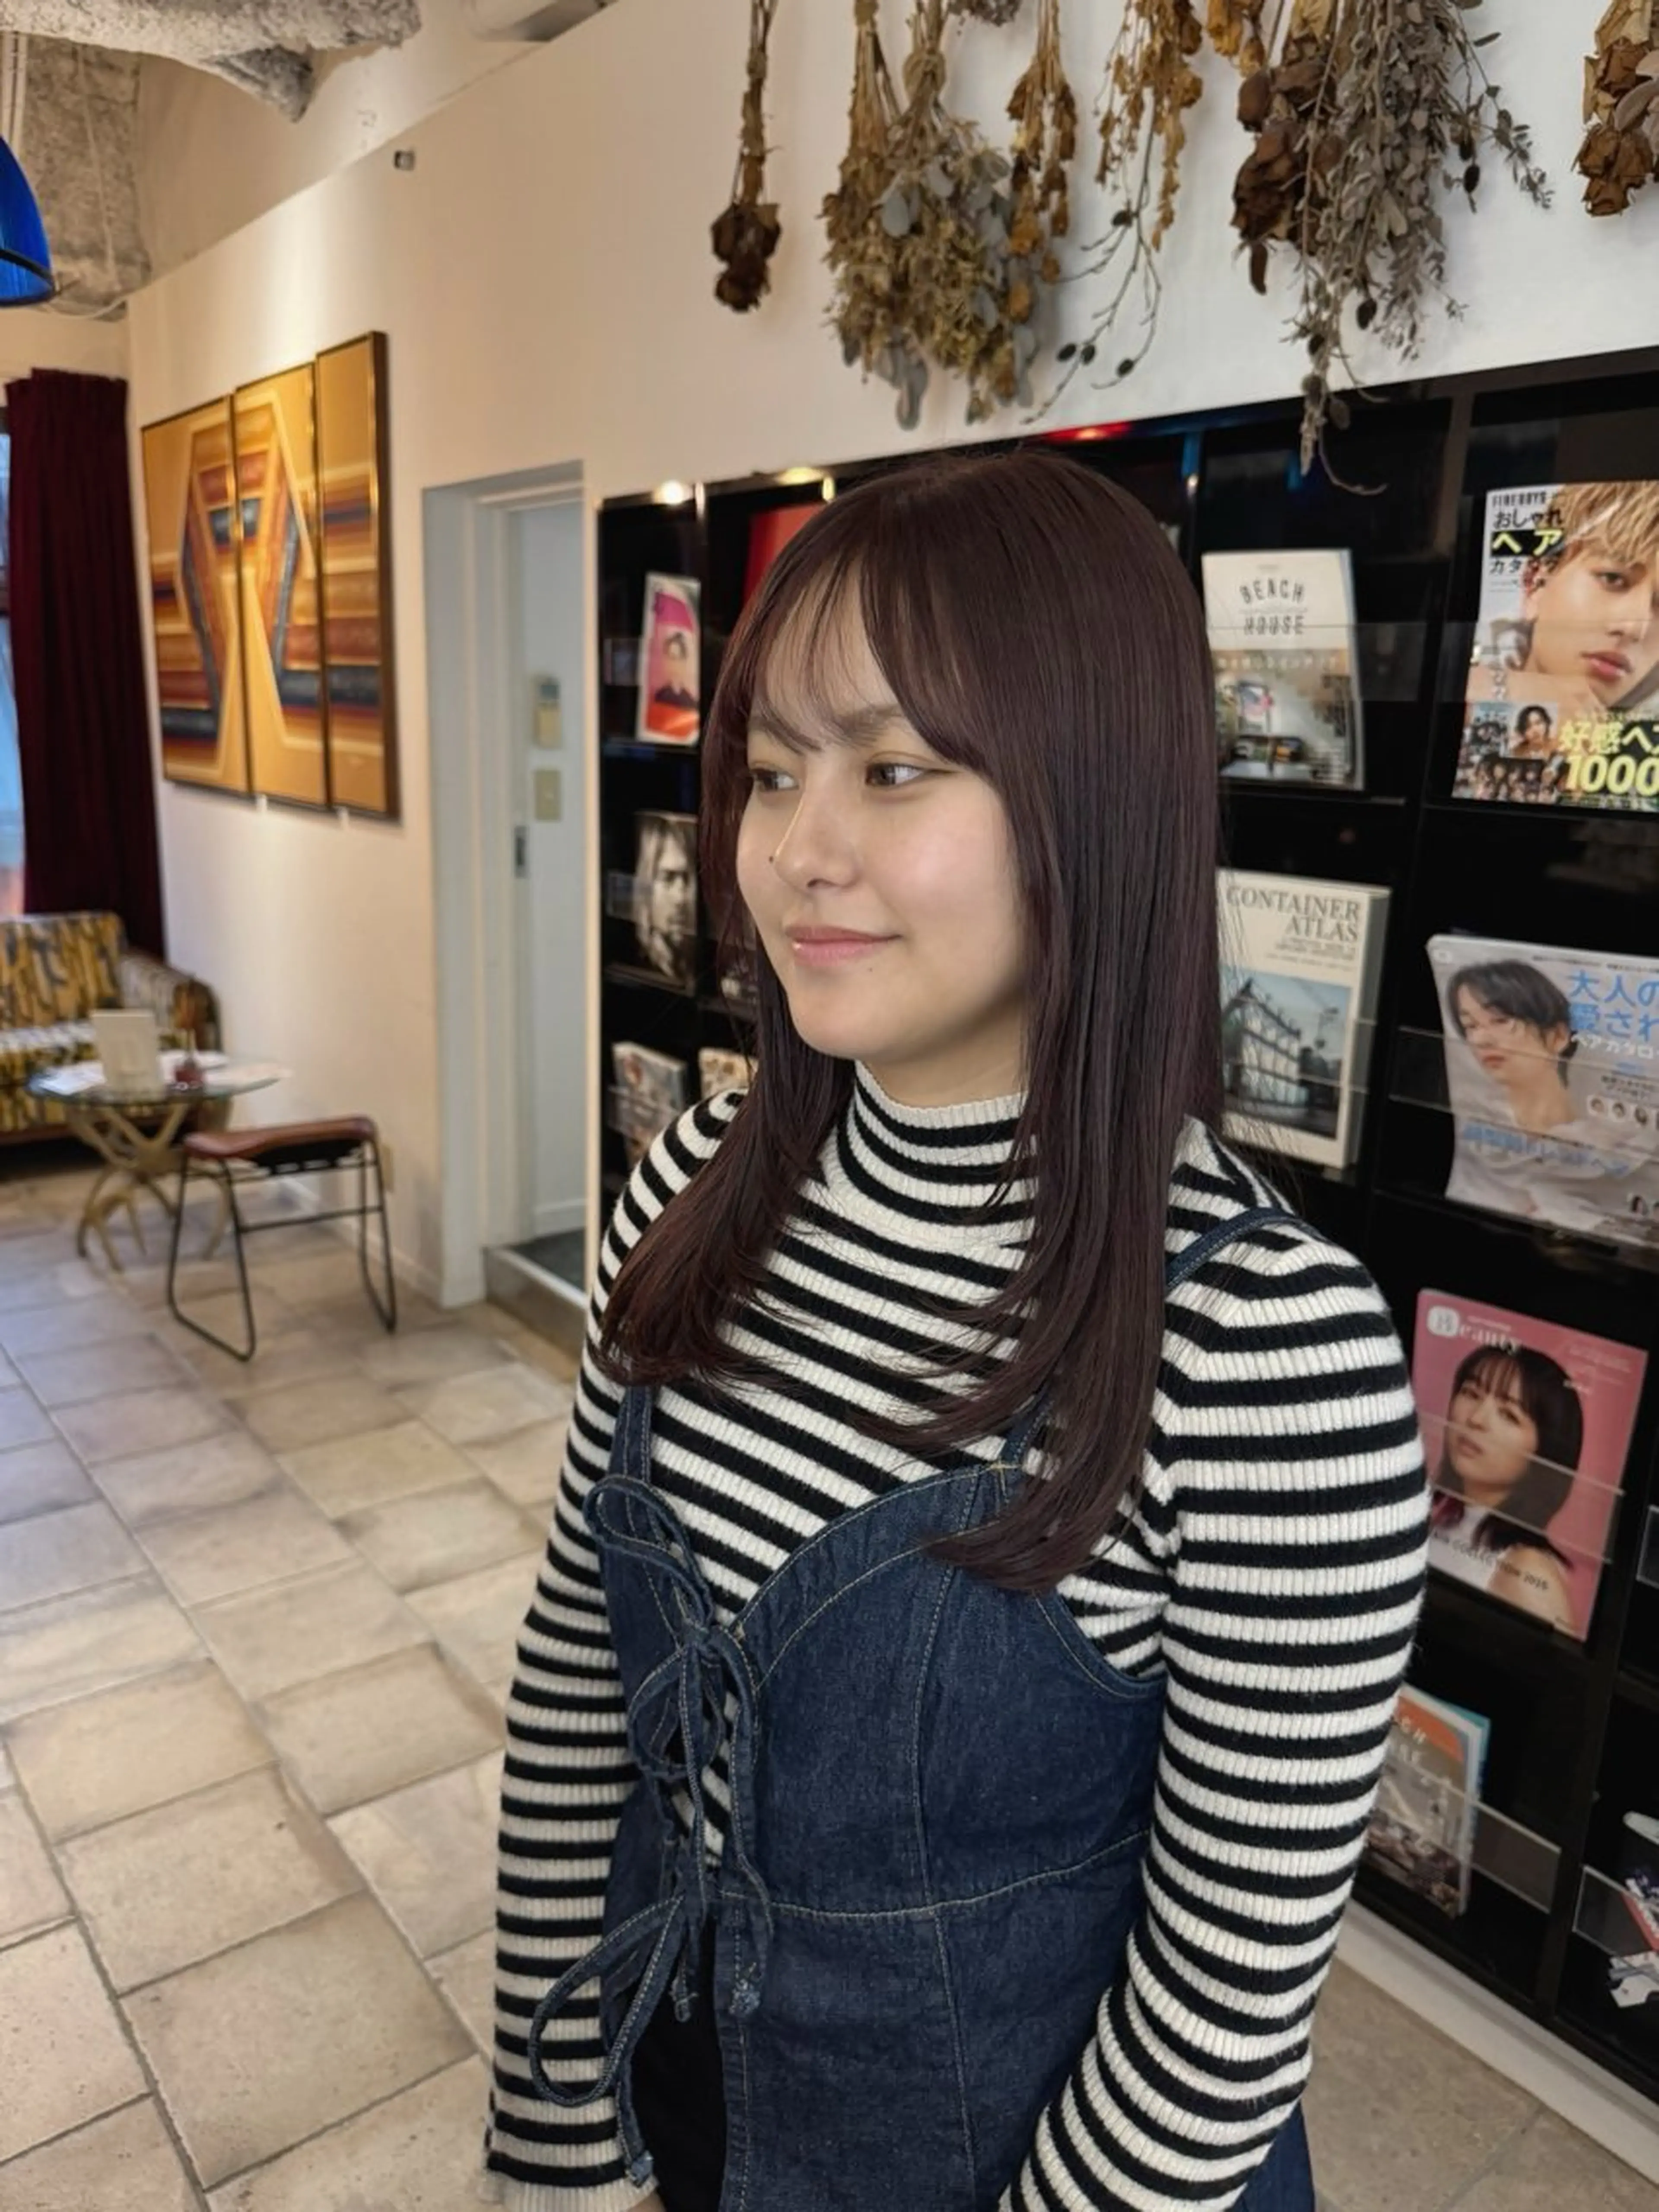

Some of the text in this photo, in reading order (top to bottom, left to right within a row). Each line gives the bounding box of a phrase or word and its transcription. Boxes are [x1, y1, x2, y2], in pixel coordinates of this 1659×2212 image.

[1494, 508, 1563, 529] おしゃれ
[1493, 529, 1563, 556] ヘア
[1239, 577, 1306, 604] BEACH
[1244, 615, 1305, 636] HOUSE
[1226, 886, 1360, 921] CONTAINER
[1284, 915, 1358, 941] ATLAS
[1566, 969, 1659, 1008] 大人の
